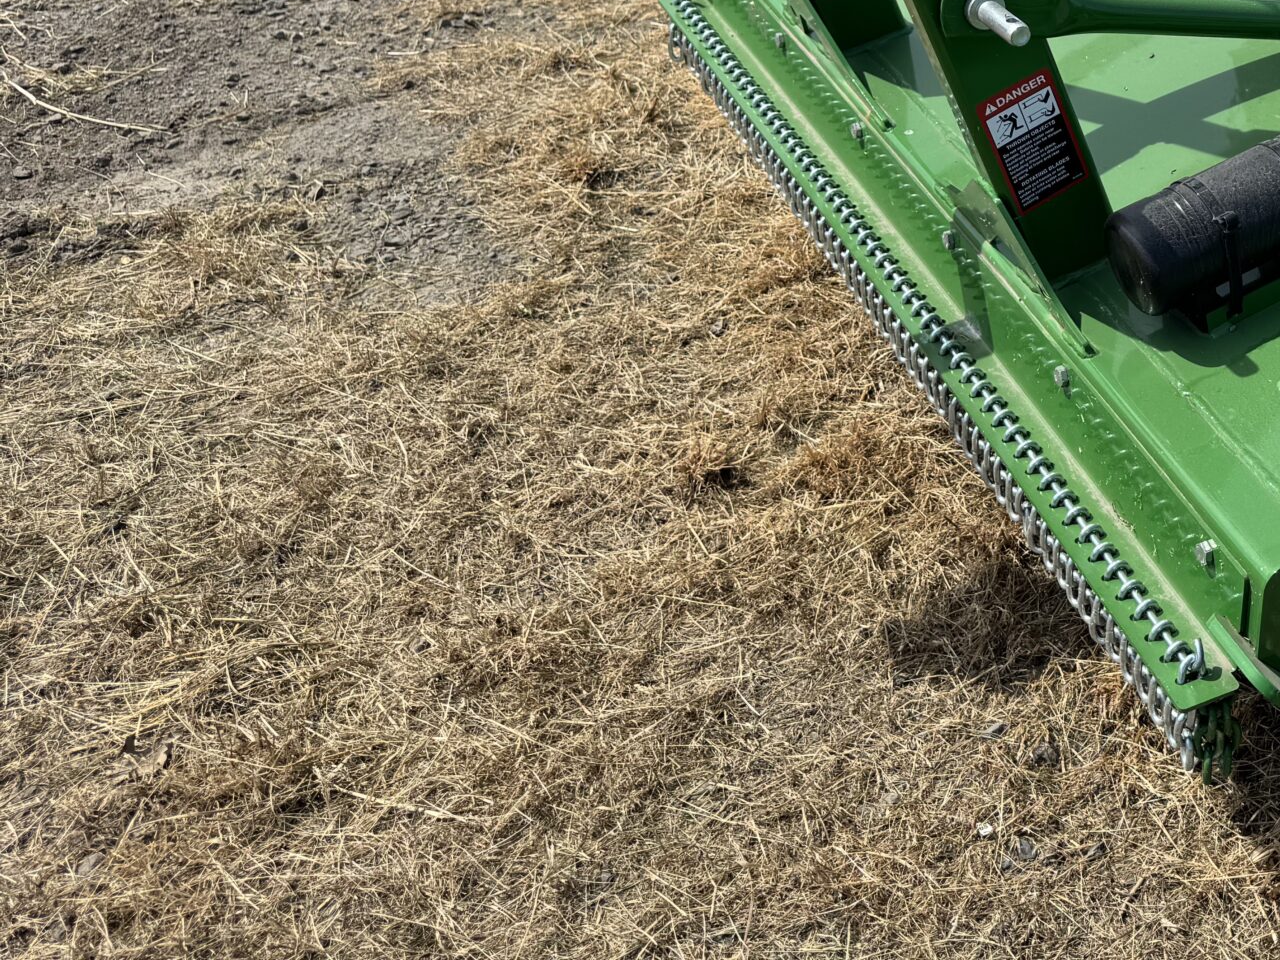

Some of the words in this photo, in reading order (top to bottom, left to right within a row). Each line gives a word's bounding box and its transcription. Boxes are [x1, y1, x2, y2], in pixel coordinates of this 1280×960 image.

[995, 74, 1047, 108] DANGER
[1007, 134, 1031, 150] THROWN
[1031, 120, 1056, 136] OBJECTS
[1021, 169, 1048, 186] ROTATING
[1048, 157, 1070, 171] BLADES
